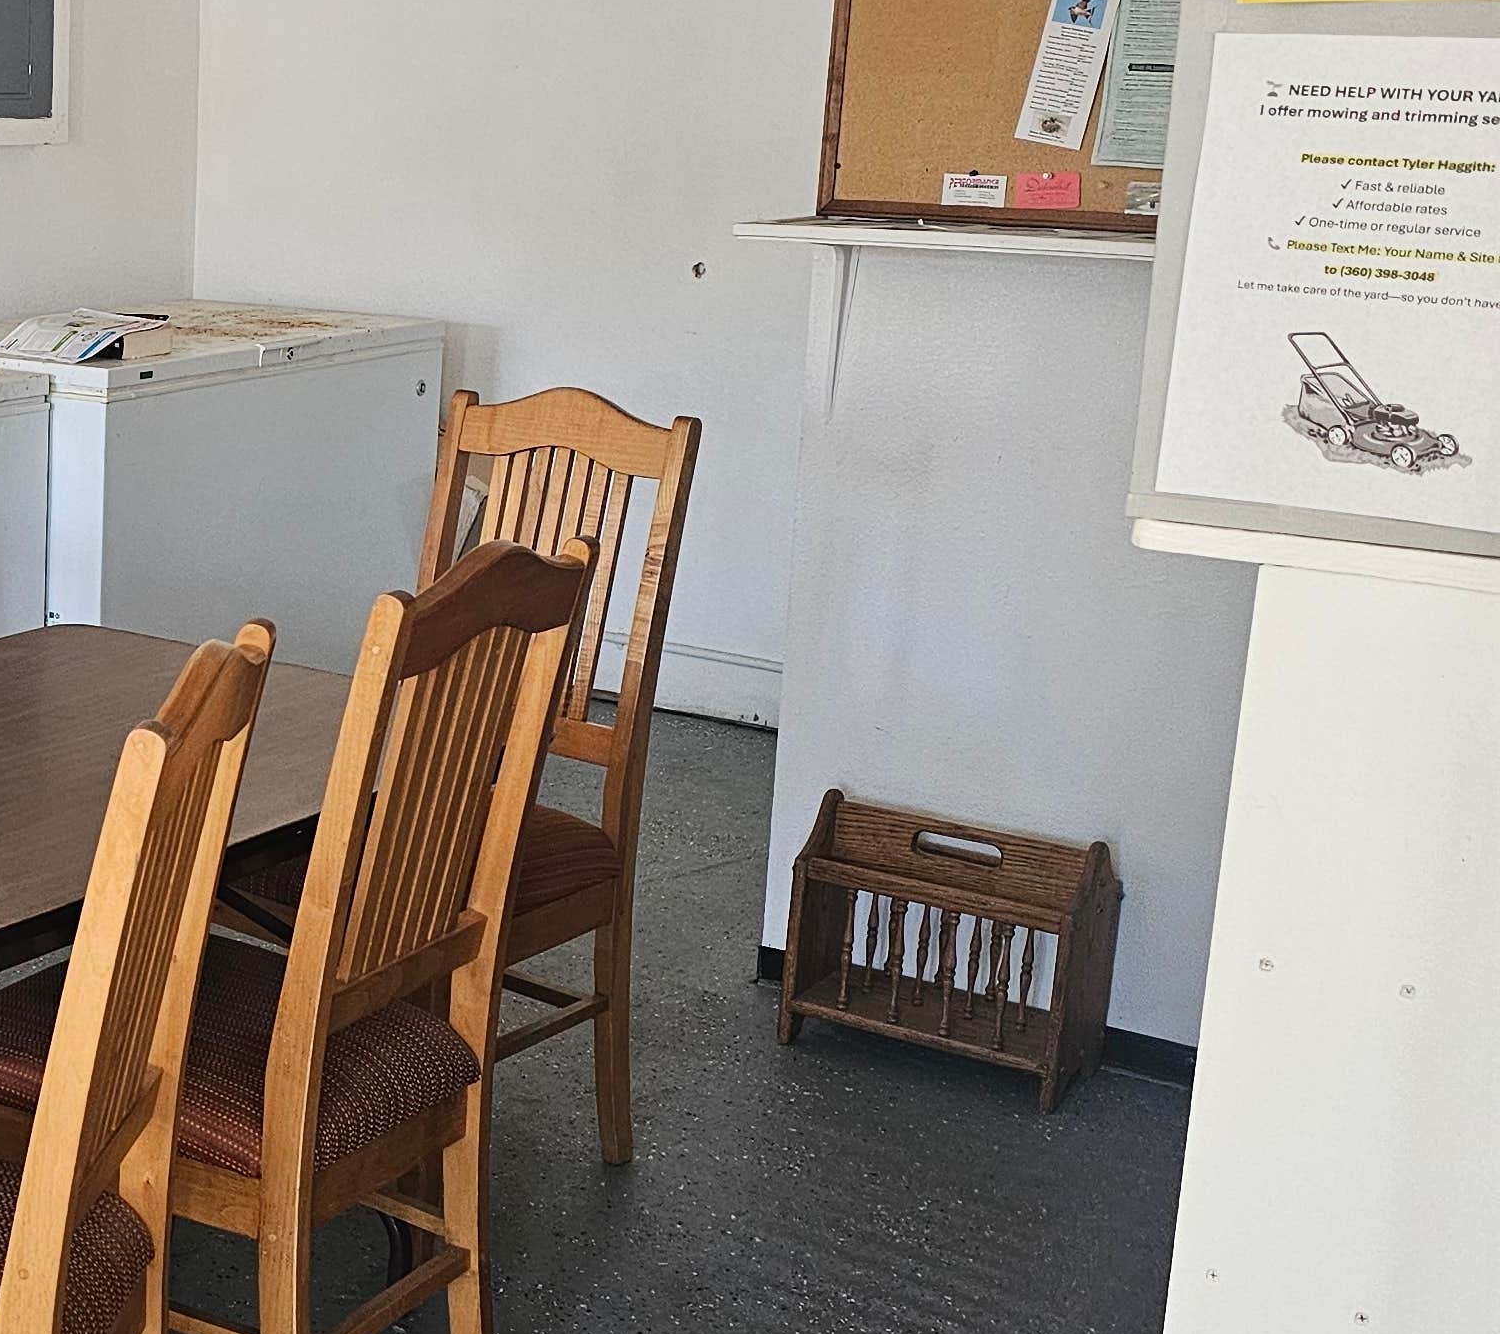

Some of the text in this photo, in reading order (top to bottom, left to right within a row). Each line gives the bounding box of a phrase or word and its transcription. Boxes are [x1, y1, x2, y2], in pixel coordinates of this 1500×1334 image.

[1288, 84, 1500, 103] NEED HELP WITH YOUR YA
[1259, 104, 1265, 116] I
[1268, 105, 1304, 117] offer
[1307, 106, 1368, 122] mowing
[1372, 108, 1400, 121] and
[1404, 111, 1478, 127] trimming
[1301, 153, 1496, 174] Please contact Tyler Haggith:
[1355, 180, 1446, 196] Fast & reliable
[1345, 199, 1448, 216] Affordable rates
[1308, 217, 1481, 238] One-time or regular service
[1287, 239, 1495, 263] Please Text Me: Your Name & Site
[1324, 265, 1435, 283] to (360) 398-3048
[1237, 279, 1255, 290] Let
[1257, 282, 1274, 292] me
[1277, 282, 1300, 294] take
[1303, 286, 1327, 296] care
[1329, 287, 1341, 297] of
[1343, 288, 1361, 299] the
[1417, 294, 1438, 306] you
